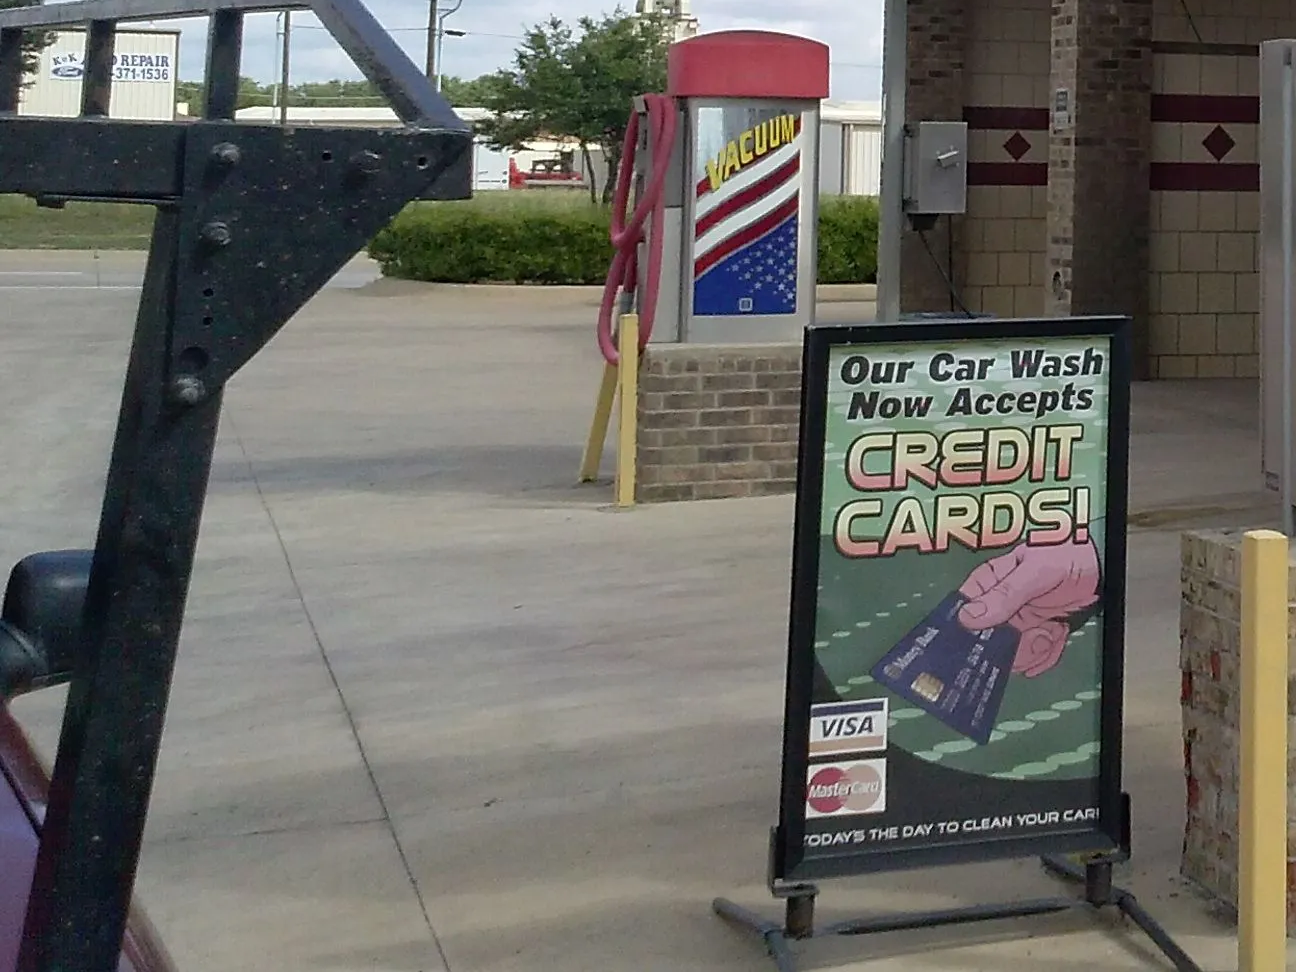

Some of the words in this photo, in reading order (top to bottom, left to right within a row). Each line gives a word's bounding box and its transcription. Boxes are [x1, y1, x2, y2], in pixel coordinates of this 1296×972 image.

[111, 67, 169, 80] -371-1536
[120, 54, 169, 67] REPAIR
[705, 114, 796, 192] VACUUM
[840, 355, 914, 386] Our
[928, 352, 996, 382] Car
[1010, 346, 1104, 379] Wash
[847, 391, 934, 420] Now
[946, 382, 1094, 418] Accepts
[845, 423, 1084, 492] CREDIT
[833, 486, 1091, 558] CARDS!
[821, 716, 874, 738] VISA
[808, 778, 881, 799] MasterCard
[870, 827, 898, 840] THE
[902, 824, 934, 837] DAY
[938, 821, 959, 834] TO
[962, 816, 1013, 832] CLEAN
[1016, 811, 1060, 826] YOUR
